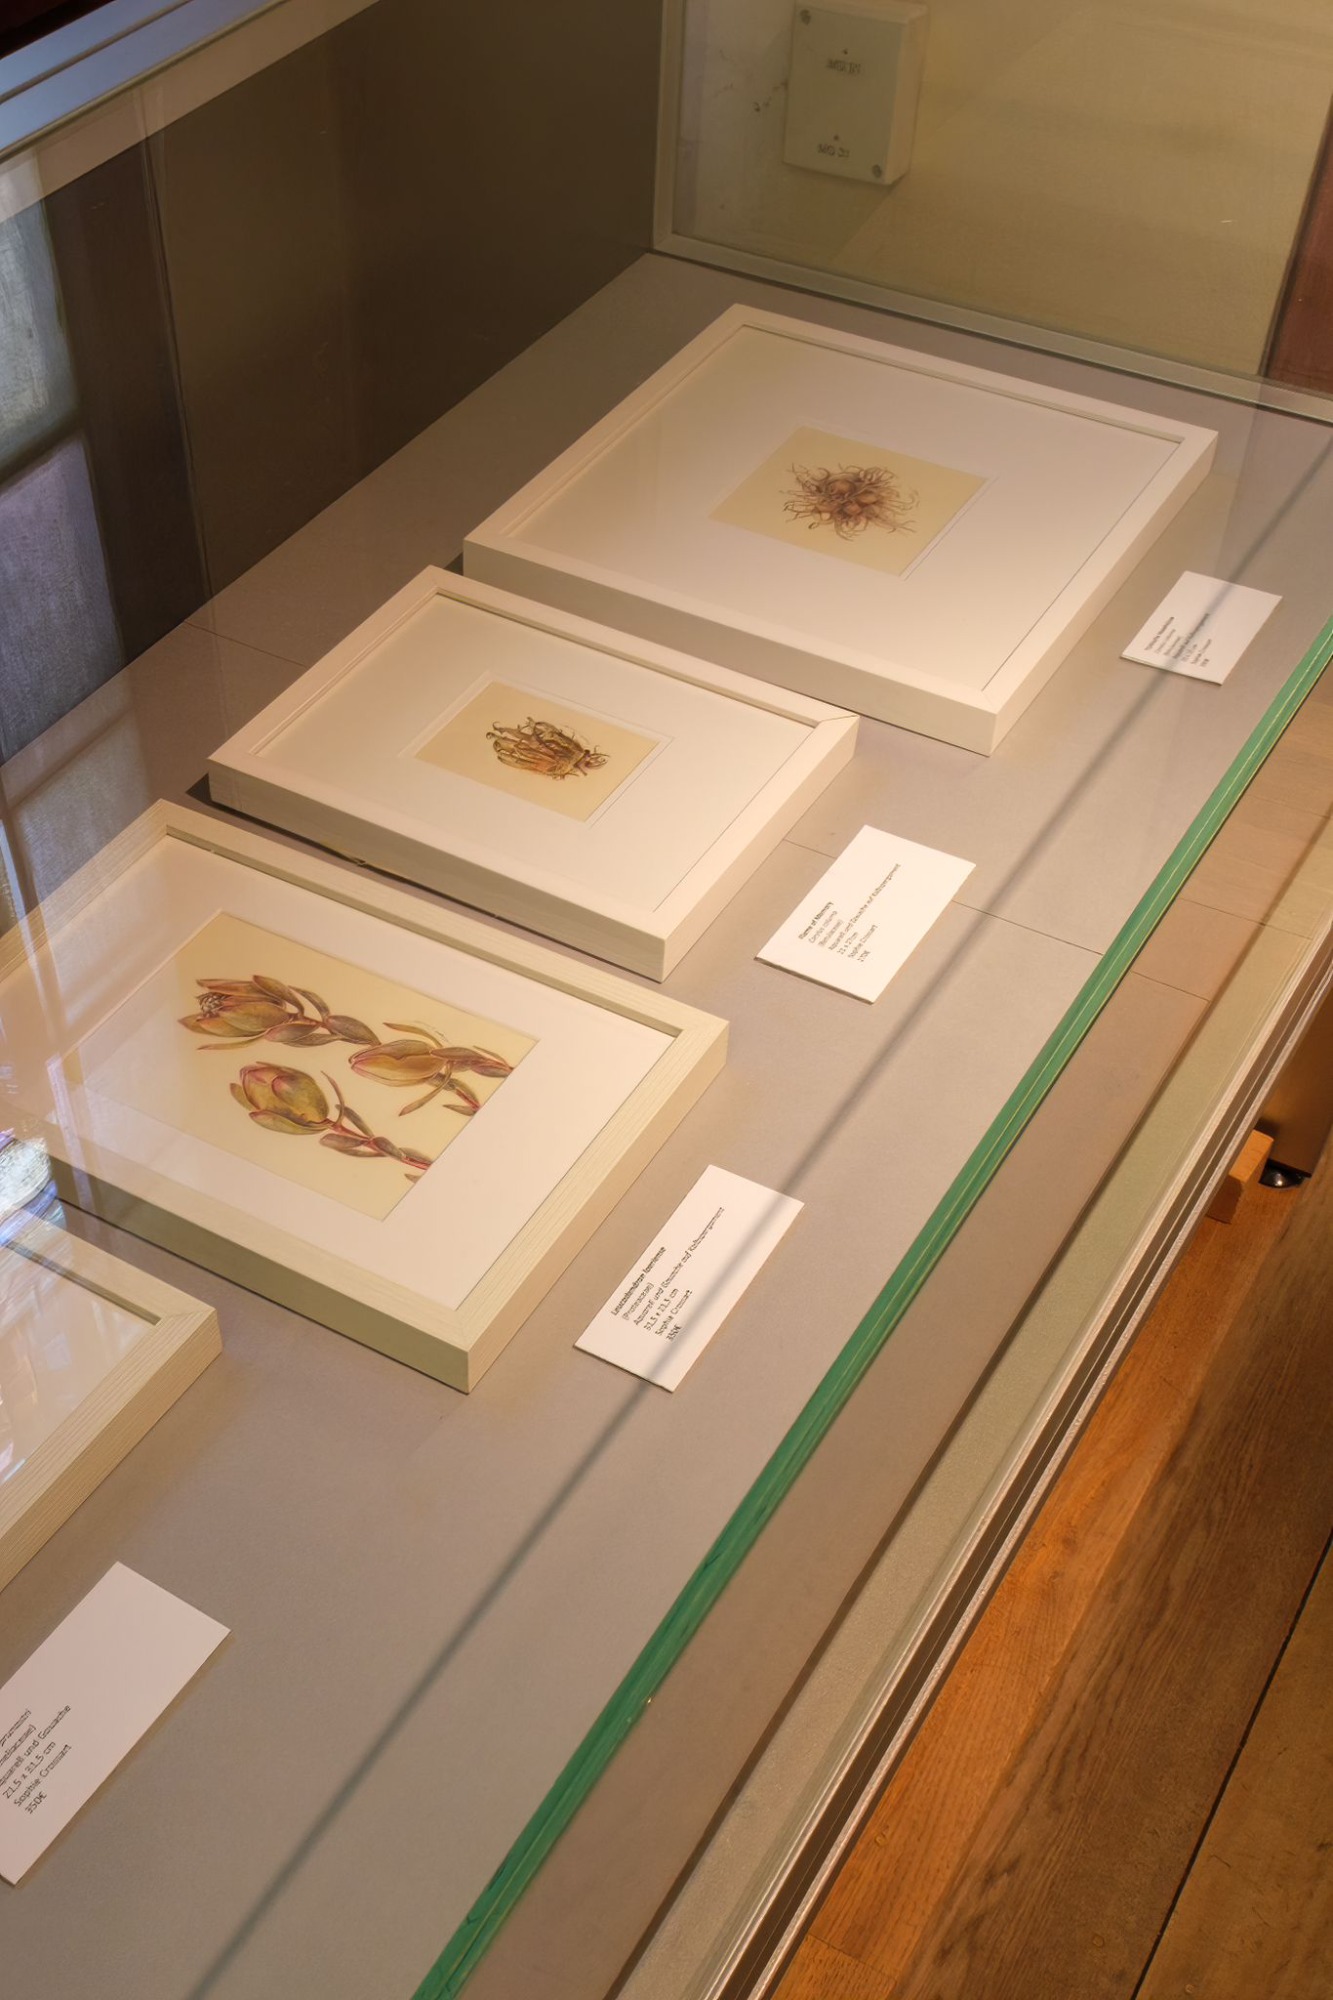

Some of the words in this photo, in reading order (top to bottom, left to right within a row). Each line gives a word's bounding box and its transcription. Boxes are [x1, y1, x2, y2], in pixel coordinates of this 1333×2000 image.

[633, 1298, 655, 1326] Aquarell
[653, 1286, 665, 1301] und
[660, 1262, 684, 1289] Gouache
[680, 1250, 692, 1264] auf
[654, 1315, 674, 1336] Sophie
[0, 1756, 24, 1786] quarell
[24, 1739, 40, 1757] und
[38, 1705, 71, 1740] Gouache
[43, 1741, 56, 1755] cm
[13, 1778, 41, 1807] Sophie
[25, 1791, 47, 1814] 350€
